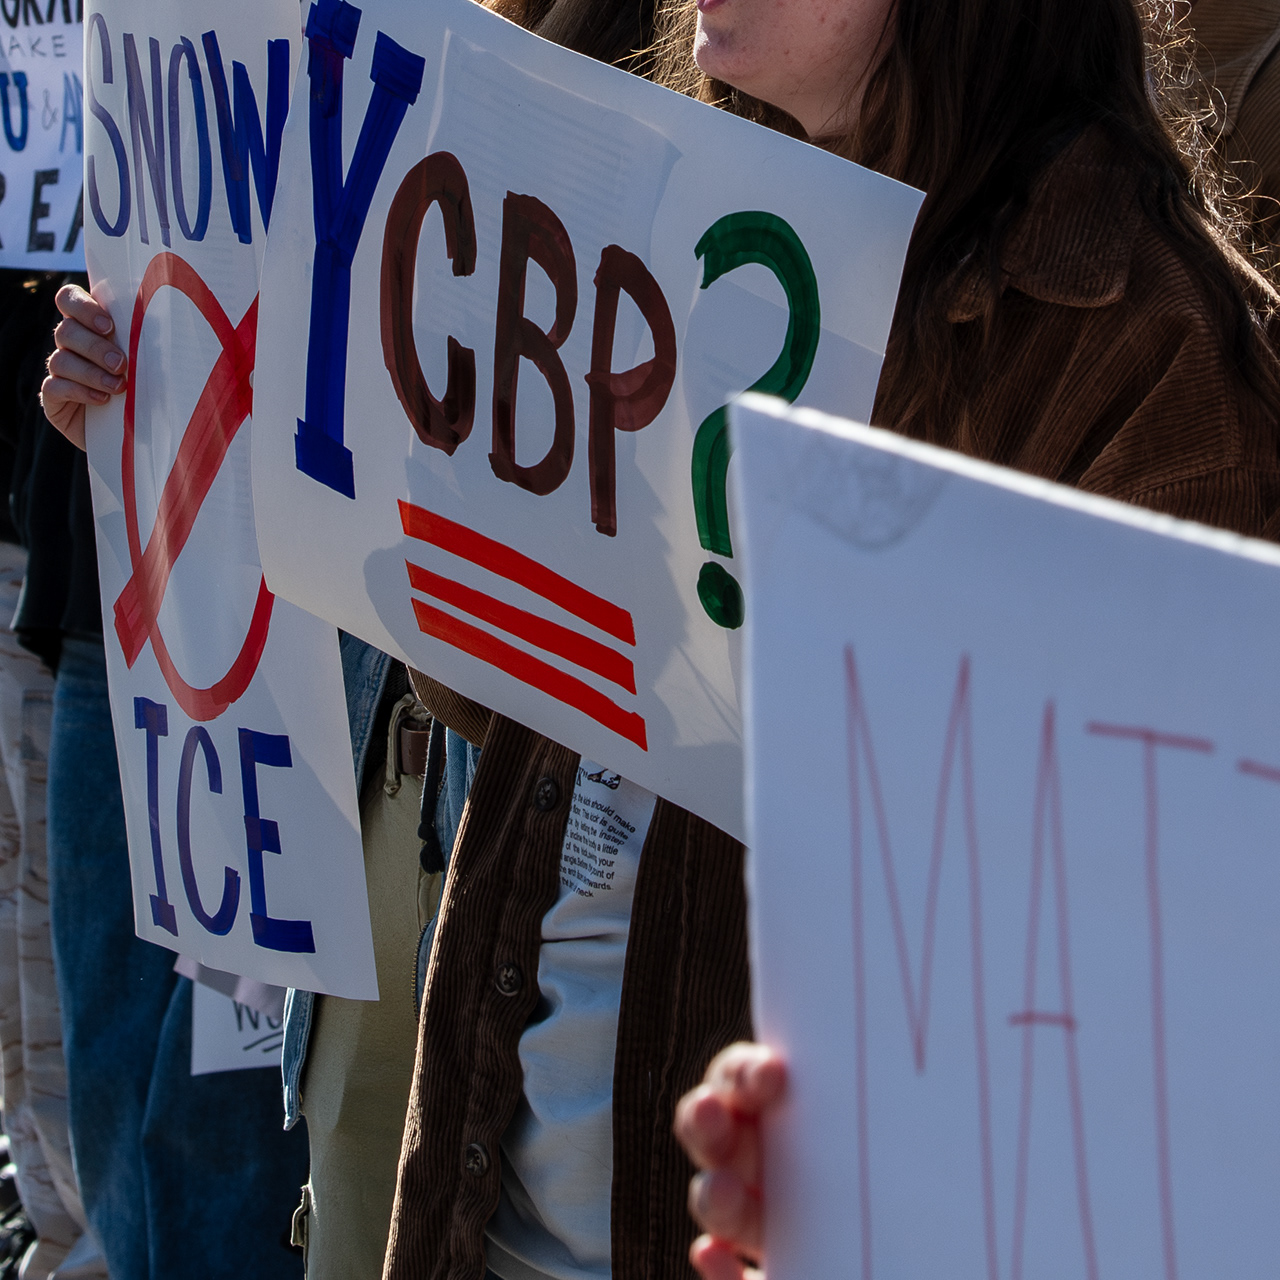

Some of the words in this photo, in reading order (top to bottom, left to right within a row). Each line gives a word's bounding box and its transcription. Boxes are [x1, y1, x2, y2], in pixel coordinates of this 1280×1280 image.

[87, 13, 290, 247] SNOW
[591, 799, 616, 818] should
[614, 814, 636, 834] make
[134, 697, 316, 954] ICE
[599, 829, 625, 846] instep
[601, 842, 618, 856] little
[598, 856, 615, 867] your
[606, 871, 615, 881] of
